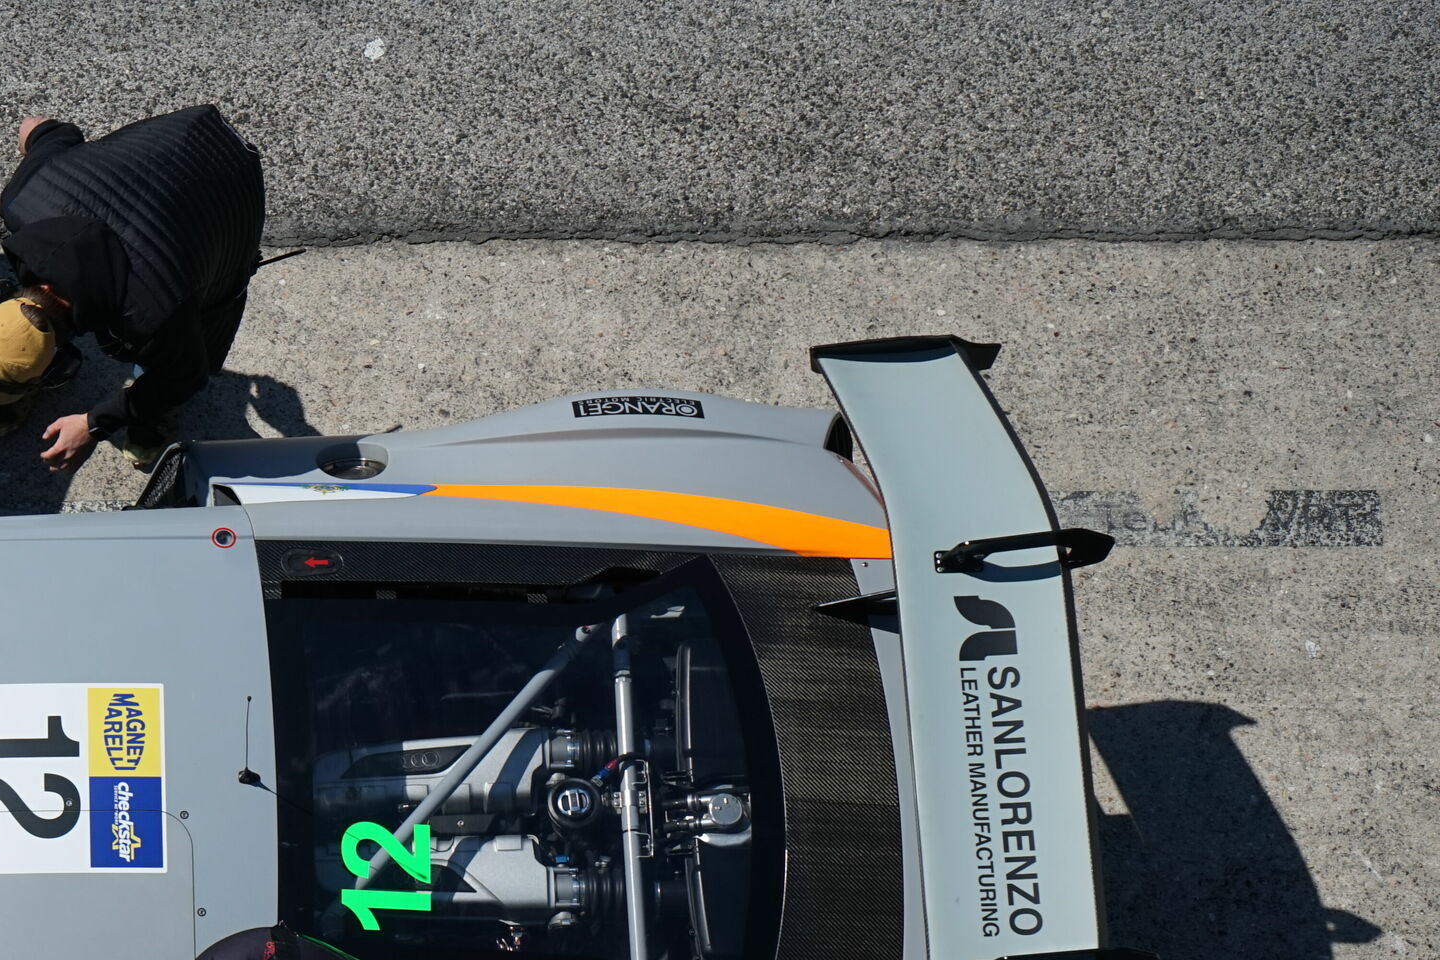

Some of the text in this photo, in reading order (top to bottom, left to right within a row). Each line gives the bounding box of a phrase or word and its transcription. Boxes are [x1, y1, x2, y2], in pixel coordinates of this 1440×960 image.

[579, 401, 698, 416] ORANGE1
[104, 694, 132, 770] MARELLI
[112, 694, 145, 770] MAGNETI
[117, 781, 134, 863] checkstar
[960, 667, 1000, 938] LEATHER MANUFACTURING
[987, 665, 1043, 936] SANLORENZO
[341, 821, 431, 931] 12
